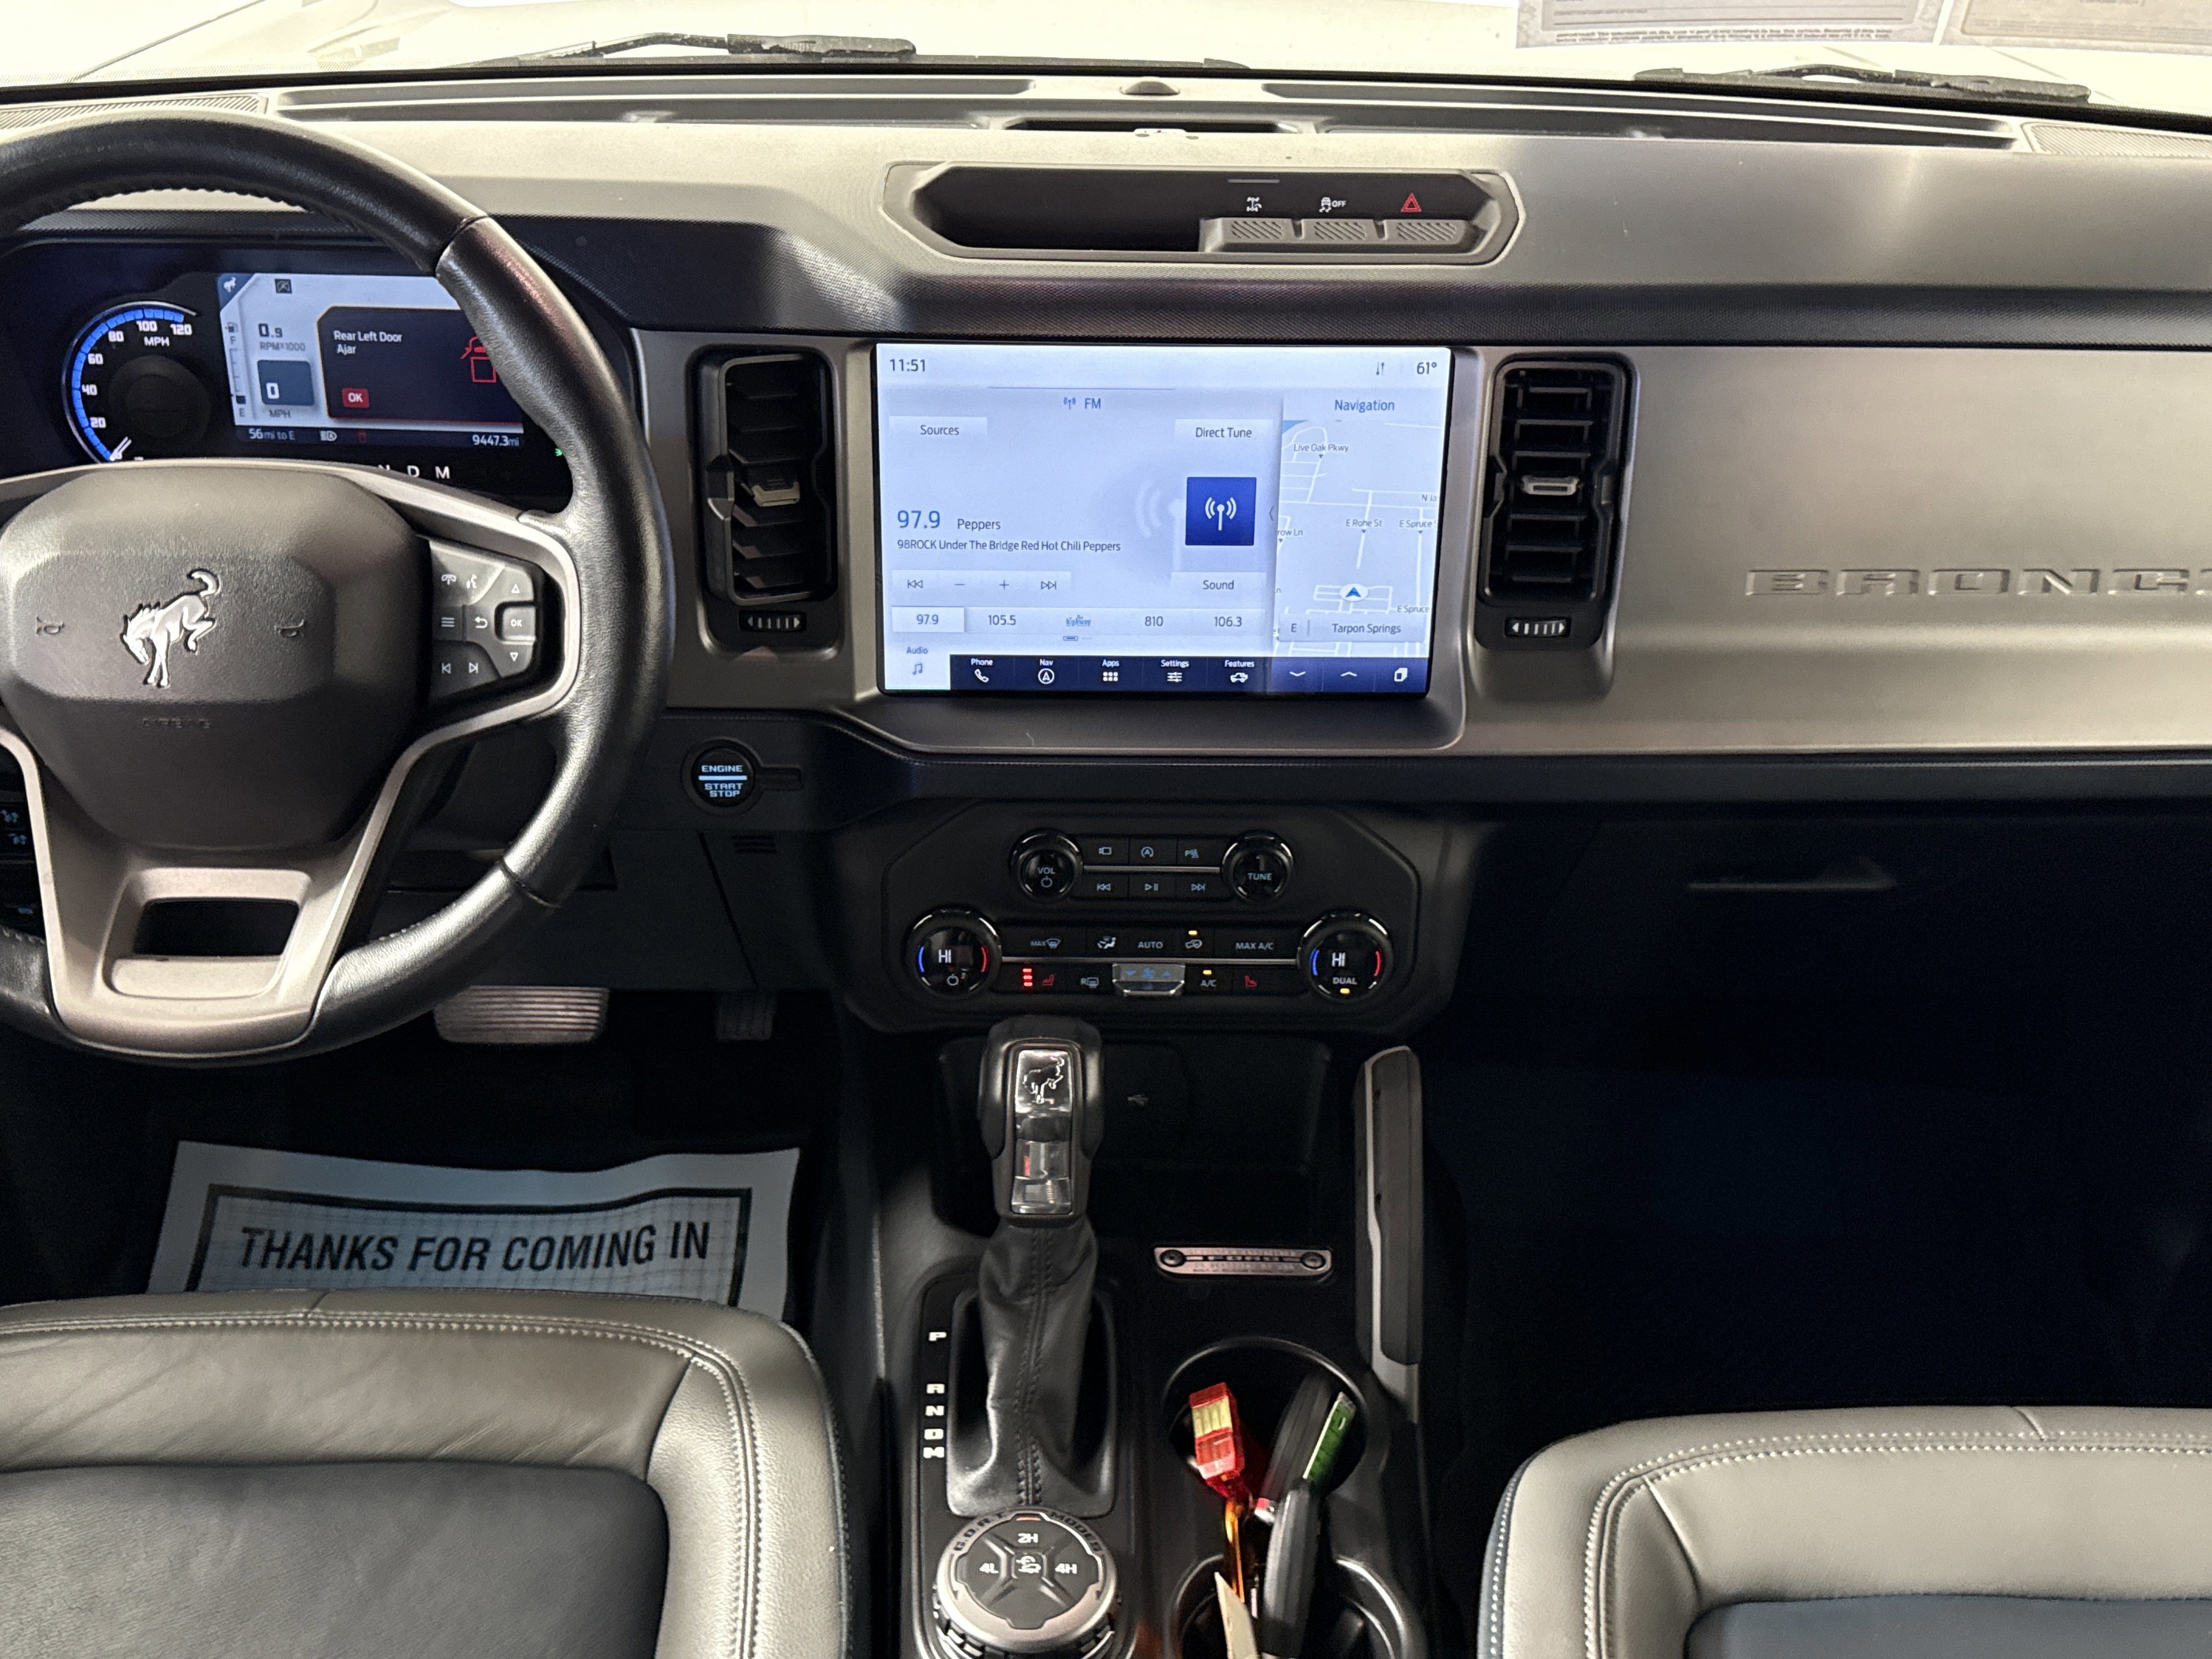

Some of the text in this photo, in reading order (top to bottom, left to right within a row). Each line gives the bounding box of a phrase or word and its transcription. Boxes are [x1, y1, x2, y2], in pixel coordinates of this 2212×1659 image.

[137, 320, 157, 332] 100
[170, 324, 193, 335] 120
[258, 323, 283, 338] 0.9
[108, 331, 124, 342] 80
[144, 336, 170, 346] MPH
[230, 336, 236, 345] F
[334, 330, 403, 343] Rear Left Door
[337, 344, 357, 356] Ajar
[88, 353, 103, 364] 60
[889, 359, 926, 373] 11:51
[1417, 362, 1437, 375] 61°
[82, 385, 97, 396] 40
[266, 382, 280, 399] 0
[348, 393, 363, 403] OK
[1085, 398, 1101, 409] FM
[1334, 399, 1395, 413] Navigation
[240, 408, 245, 417] E
[269, 409, 291, 419] MPH
[90, 417, 106, 428] 20
[277, 431, 287, 439] to
[289, 431, 295, 439] E
[920, 425, 960, 436] Sources
[1195, 427, 1252, 438] Direct Tune
[1293, 443, 1349, 454] Live Oak Pkwy
[407, 465, 420, 478] D
[435, 466, 450, 479] M
[897, 510, 1001, 531] 97.9 Peppers
[1346, 518, 1383, 527] E Rohe St
[1399, 520, 1404, 528] E
[1406, 520, 1432, 528] Spruce
[898, 539, 1121, 552] 98ROCK Under The Bridge Red Hot Chili Peppers
[1203, 579, 1234, 591] Sound
[1746, 567, 2212, 597] BRONC
[1403, 605, 1429, 614] Spruce
[510, 618, 522, 627] OK
[916, 614, 939, 625] 97.9
[988, 614, 1016, 626] 105.5
[1144, 616, 1163, 627] 810
[1214, 616, 1242, 628] 106.3
[1291, 623, 1297, 633] E
[1332, 624, 1364, 635] Tarpon
[1367, 624, 1401, 635] Springs
[906, 646, 928, 655] Audio
[970, 658, 993, 667] Phone
[1040, 658, 1053, 667] Nav
[1102, 659, 1120, 668] Apps
[1160, 659, 1189, 669] Settings
[1224, 660, 1255, 668] Features
[1037, 867, 1056, 875] VOL
[1248, 872, 1272, 881] TUNE
[1137, 941, 1164, 949] AUTO
[1257, 942, 1274, 951] A/C
[938, 949, 952, 964] HI
[1331, 952, 1345, 968] HI
[1200, 979, 1216, 989] A/C
[1333, 977, 1357, 985] DUAL
[241, 1221, 711, 1273] THANKS FOR COMING IN
[928, 1331, 947, 1341] P
[926, 1405, 945, 1417] N
[923, 1446, 945, 1459] M
[1018, 1533, 1039, 1543] 2H
[979, 1562, 999, 1574] 4L
[1055, 1563, 1077, 1574] 4H
